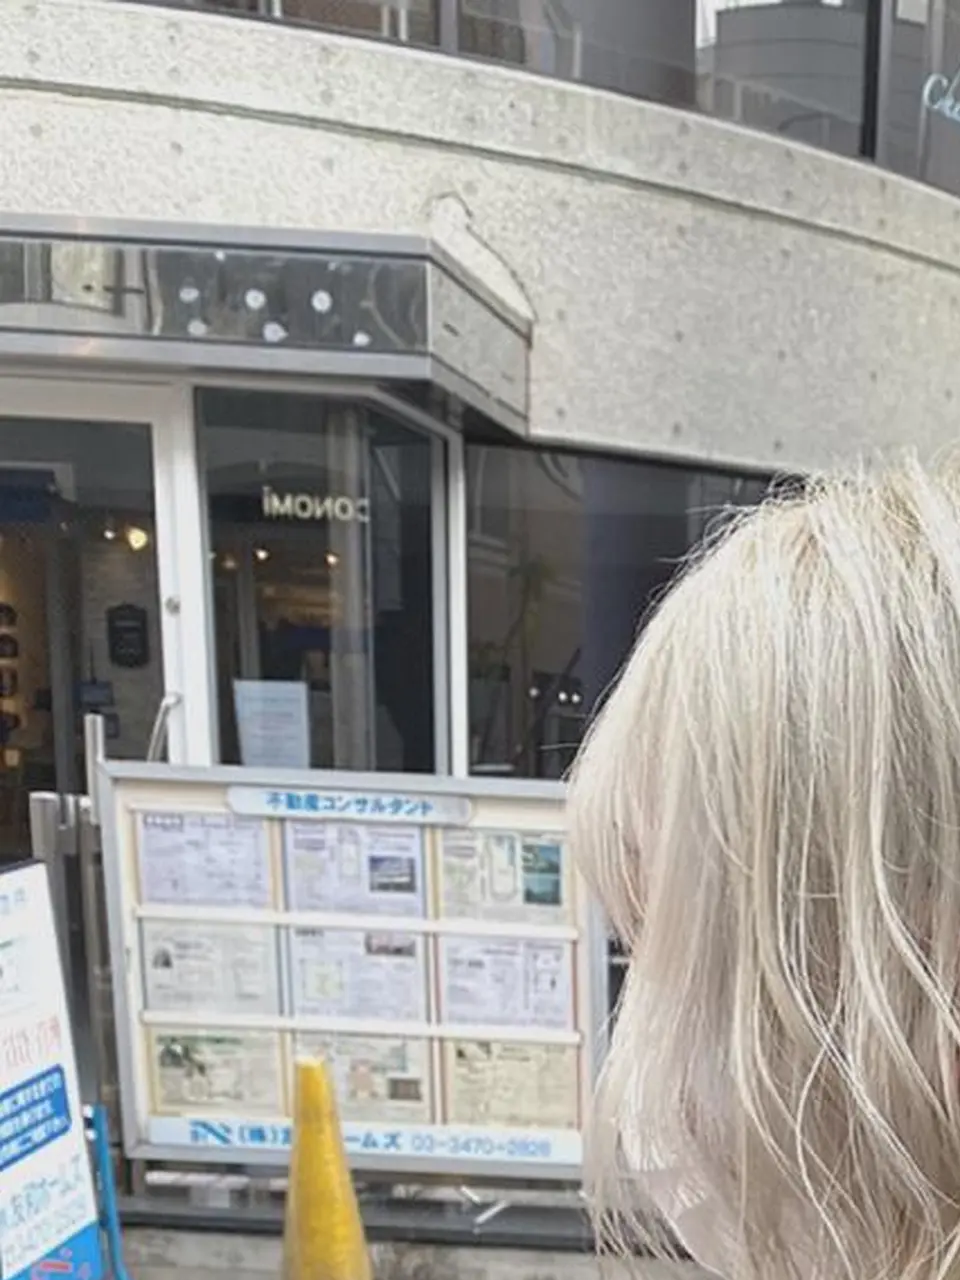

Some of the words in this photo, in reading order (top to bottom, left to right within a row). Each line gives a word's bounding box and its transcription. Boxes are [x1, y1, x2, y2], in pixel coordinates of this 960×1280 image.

[265, 791, 433, 817] 不動産コンサルタント
